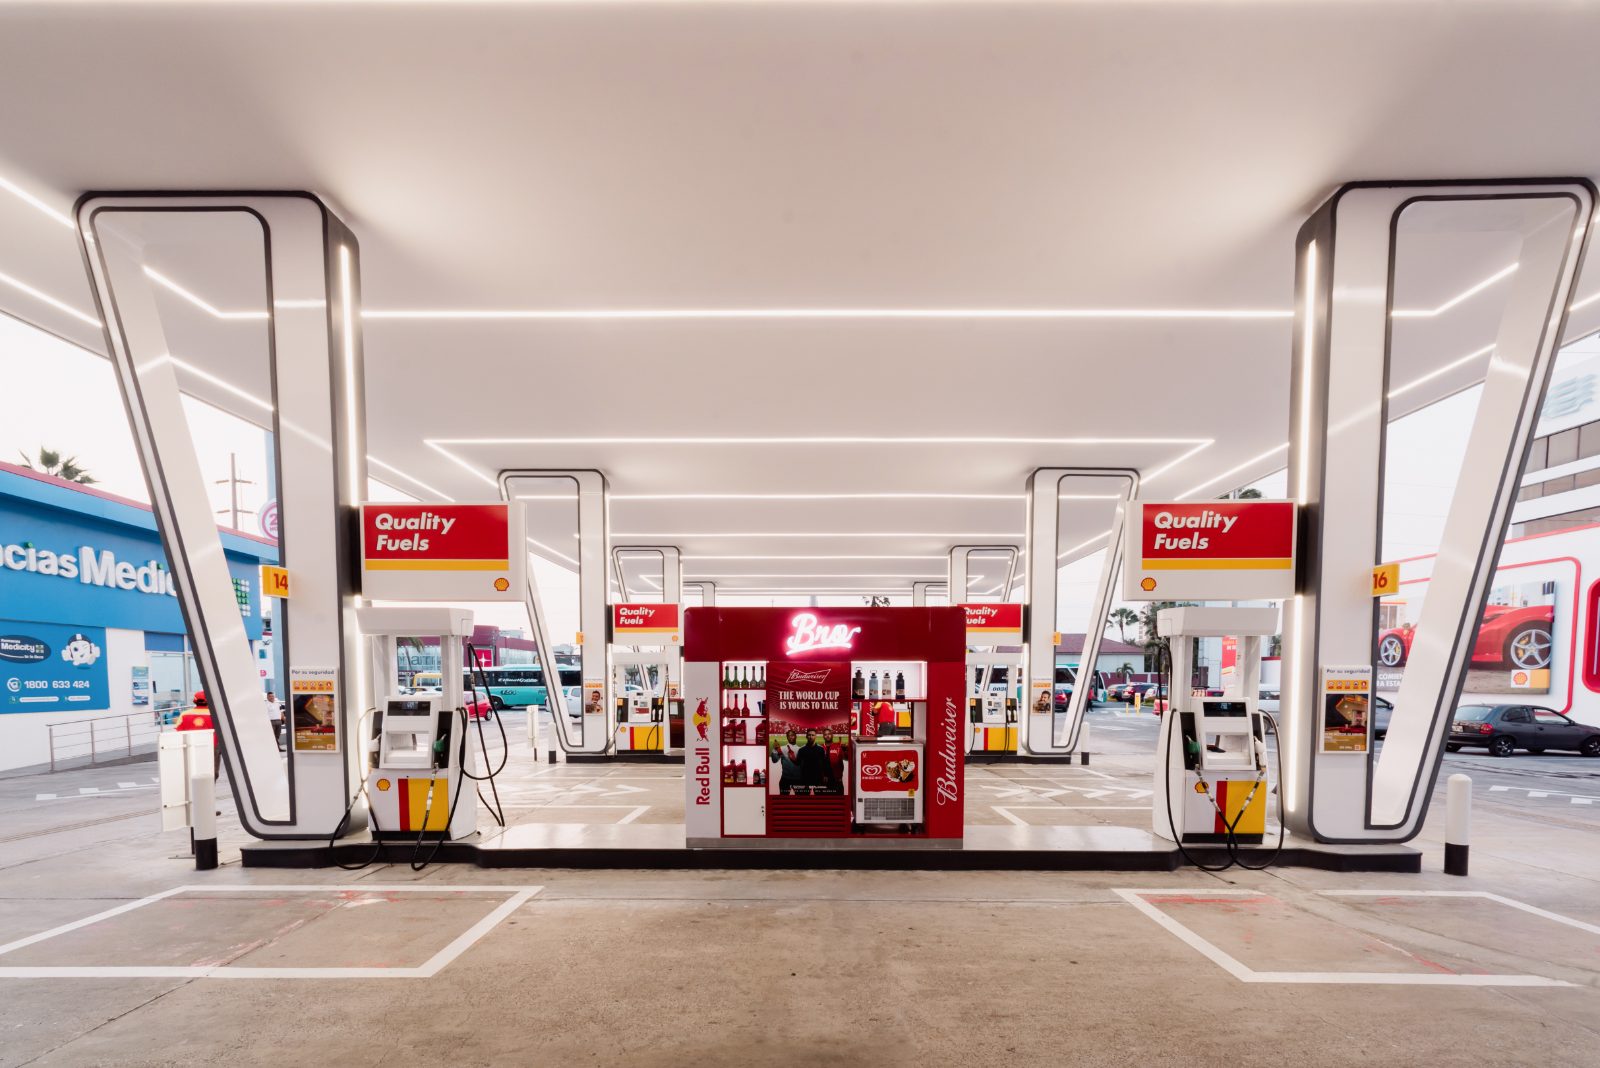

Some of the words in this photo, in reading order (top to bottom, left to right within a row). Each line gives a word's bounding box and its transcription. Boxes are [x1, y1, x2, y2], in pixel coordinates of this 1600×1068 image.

[375, 512, 456, 535] Quality
[1154, 510, 1238, 533] Quality
[376, 533, 429, 551] Fuels
[1153, 531, 1209, 550] Fuels
[0, 541, 78, 579] cias
[273, 573, 288, 590] 14
[1373, 571, 1388, 589] 16
[620, 606, 655, 617] Quality
[620, 616, 644, 625] Fuels
[965, 616, 986, 625] uels
[23, 680, 49, 689] 1800
[52, 680, 71, 689] 633
[72, 680, 91, 689] 424
[790, 672, 827, 680] Budweiser
[779, 691, 794, 700] THE
[795, 691, 823, 700] WORLD
[824, 691, 840, 700] CUP
[780, 701, 787, 710] IS
[788, 701, 810, 710] YOURS
[811, 701, 820, 710] TO
[821, 701, 839, 710] TAKE
[936, 697, 957, 806] Budweiser
[695, 747, 710, 775] Bull
[695, 777, 711, 805] Red
